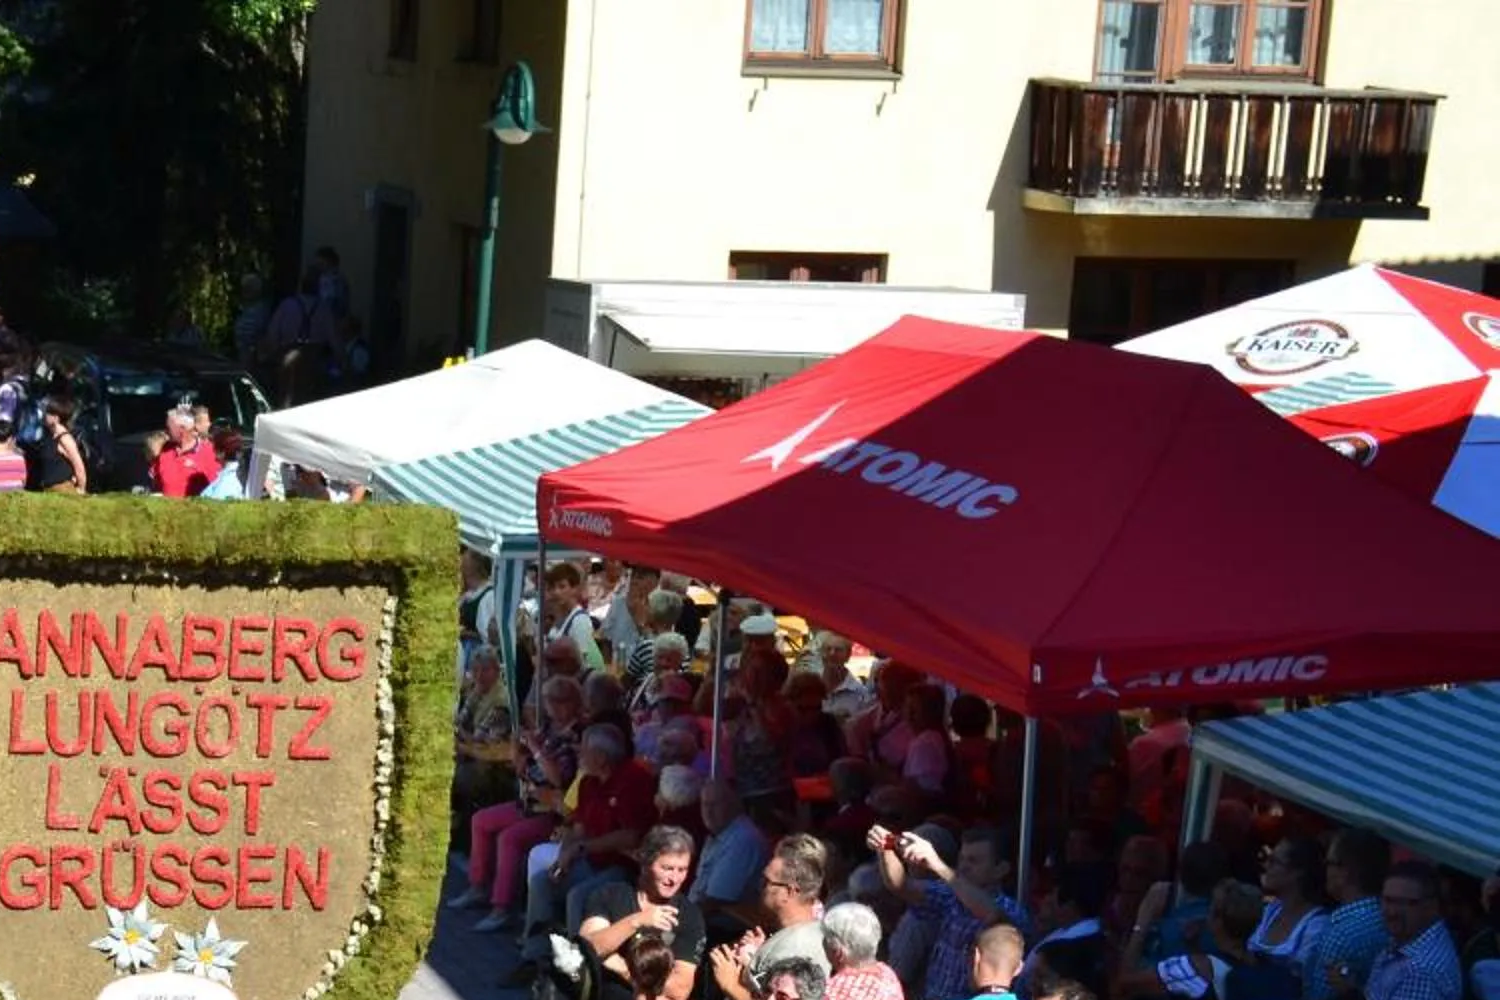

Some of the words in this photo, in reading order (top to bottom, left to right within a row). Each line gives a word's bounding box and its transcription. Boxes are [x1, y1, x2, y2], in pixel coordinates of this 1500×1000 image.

[1247, 338, 1340, 354] KAISER
[797, 437, 1020, 519] ATOMIC
[560, 509, 613, 537] ATOMIC
[8, 686, 332, 760] LUNGÖTZ
[45, 763, 275, 834] LÄSST
